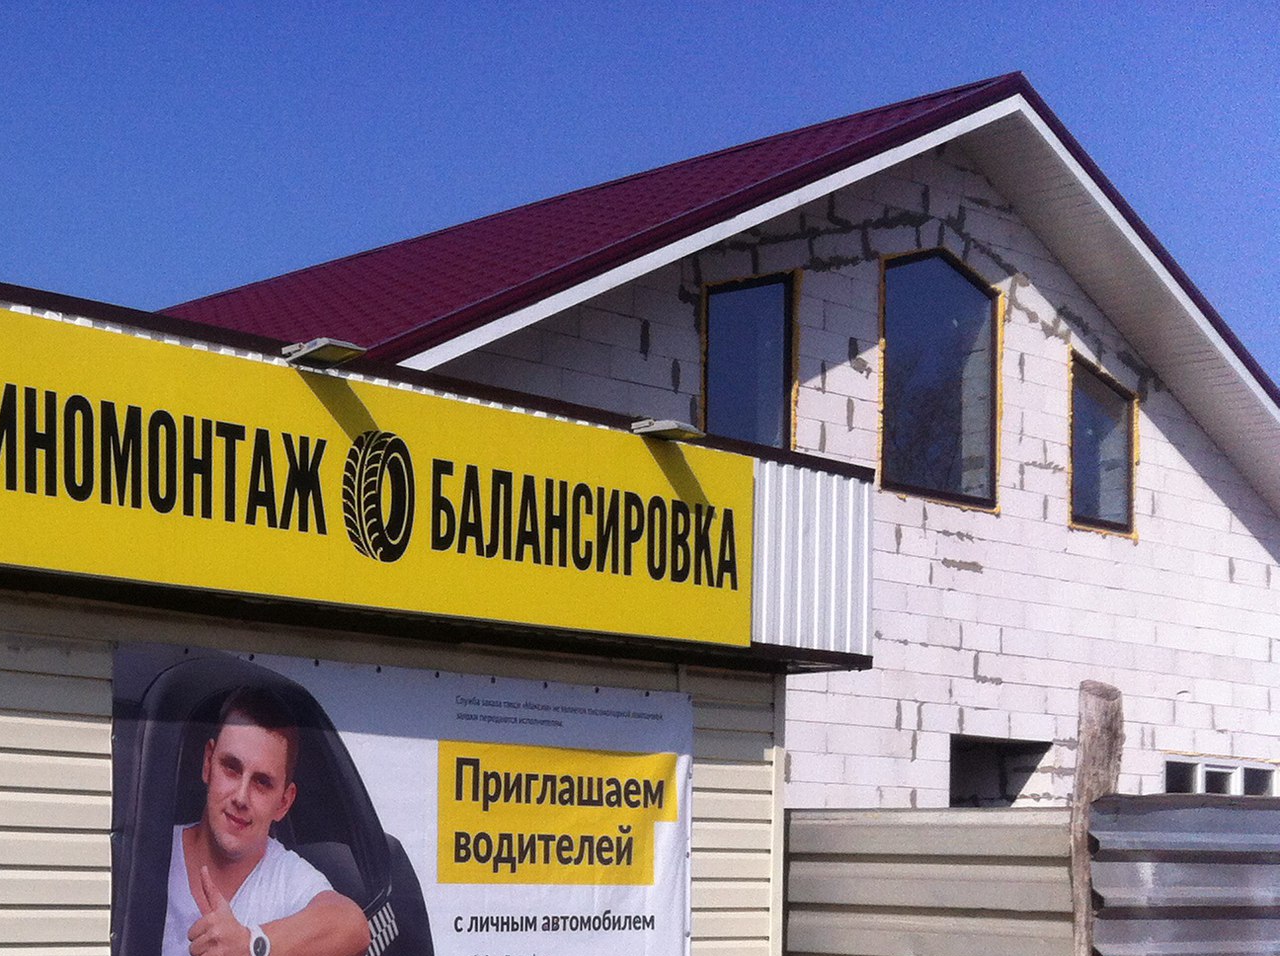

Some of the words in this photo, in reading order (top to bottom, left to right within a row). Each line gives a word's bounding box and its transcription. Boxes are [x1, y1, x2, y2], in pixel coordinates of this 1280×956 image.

[430, 458, 740, 592] БАЛАНСИРОВКА
[455, 757, 665, 812] Приглашаем
[454, 825, 634, 873] водителей
[454, 915, 463, 933] с
[466, 913, 537, 933] личным
[541, 910, 655, 932] автомобилем
